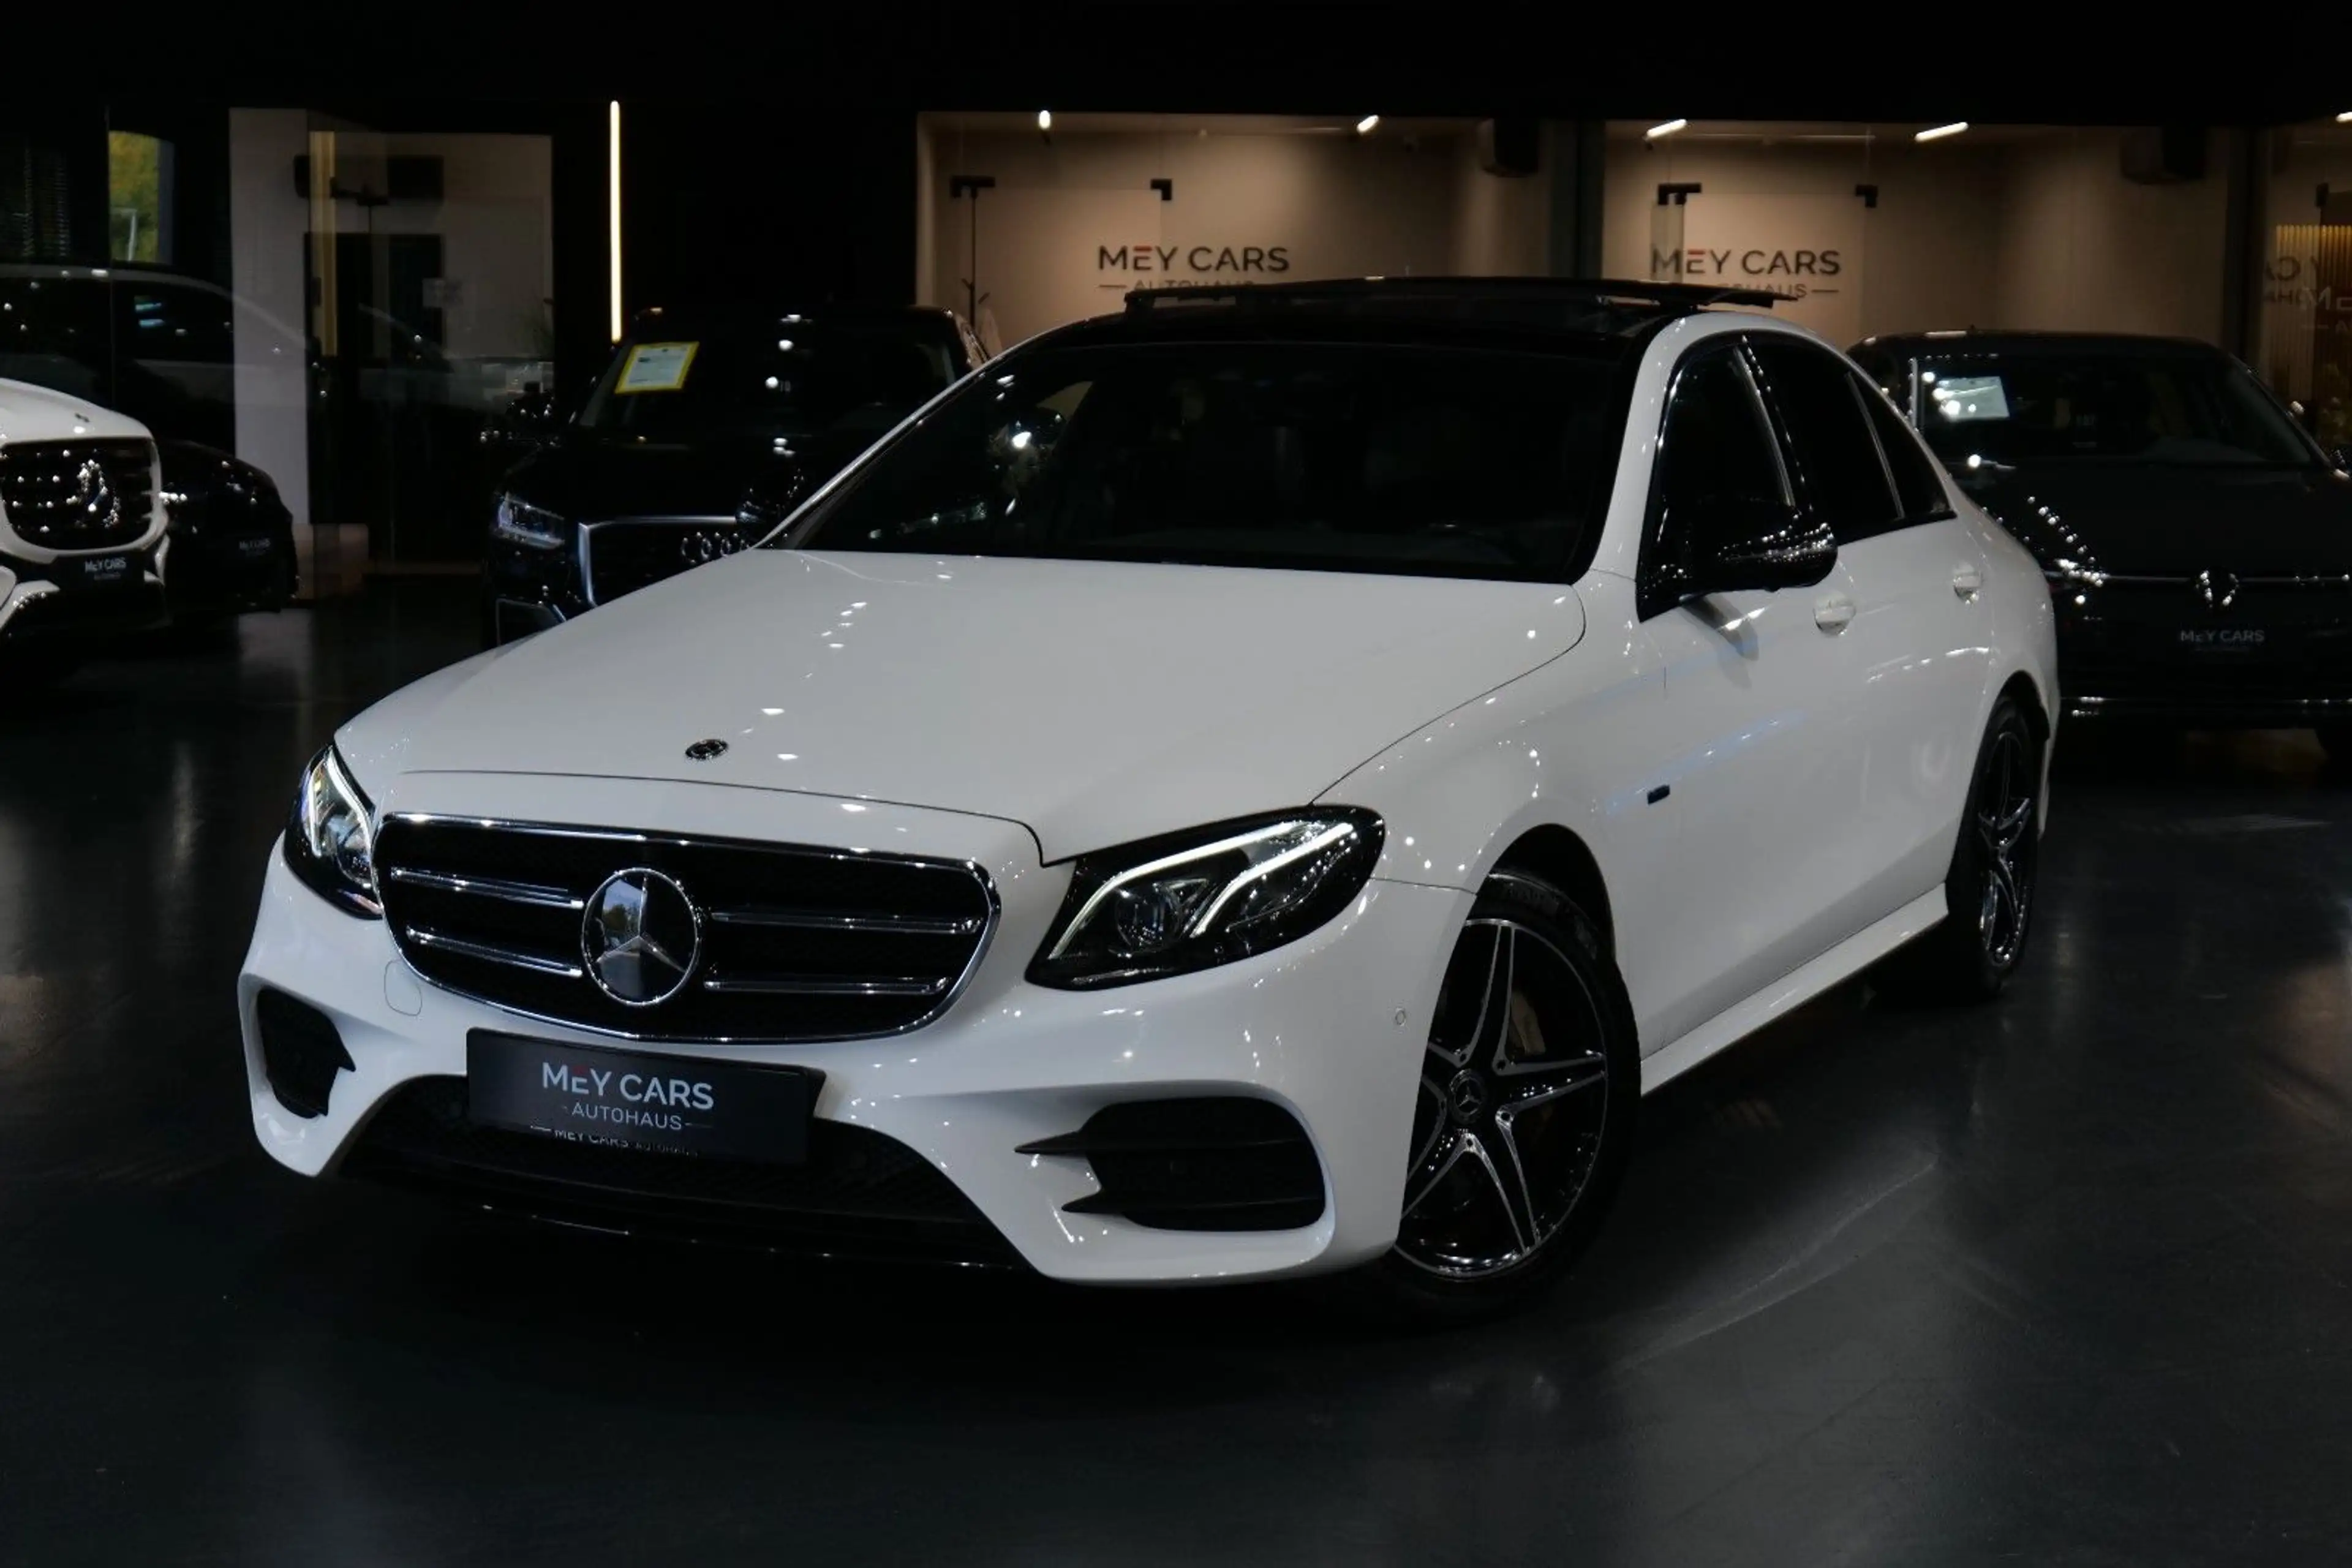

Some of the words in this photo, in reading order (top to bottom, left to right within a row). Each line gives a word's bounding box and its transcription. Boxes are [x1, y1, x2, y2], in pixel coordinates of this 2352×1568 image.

[1099, 245, 1178, 270] MEY
[1189, 246, 1290, 271] CARS
[1652, 247, 1732, 274] MEY
[1742, 249, 1841, 275] CARS
[2180, 629, 2217, 643] MEY
[2219, 629, 2266, 643] CARS
[542, 1061, 612, 1096] MEY
[619, 1073, 715, 1111] CARS
[571, 1101, 682, 1131] AUTOHAUS
